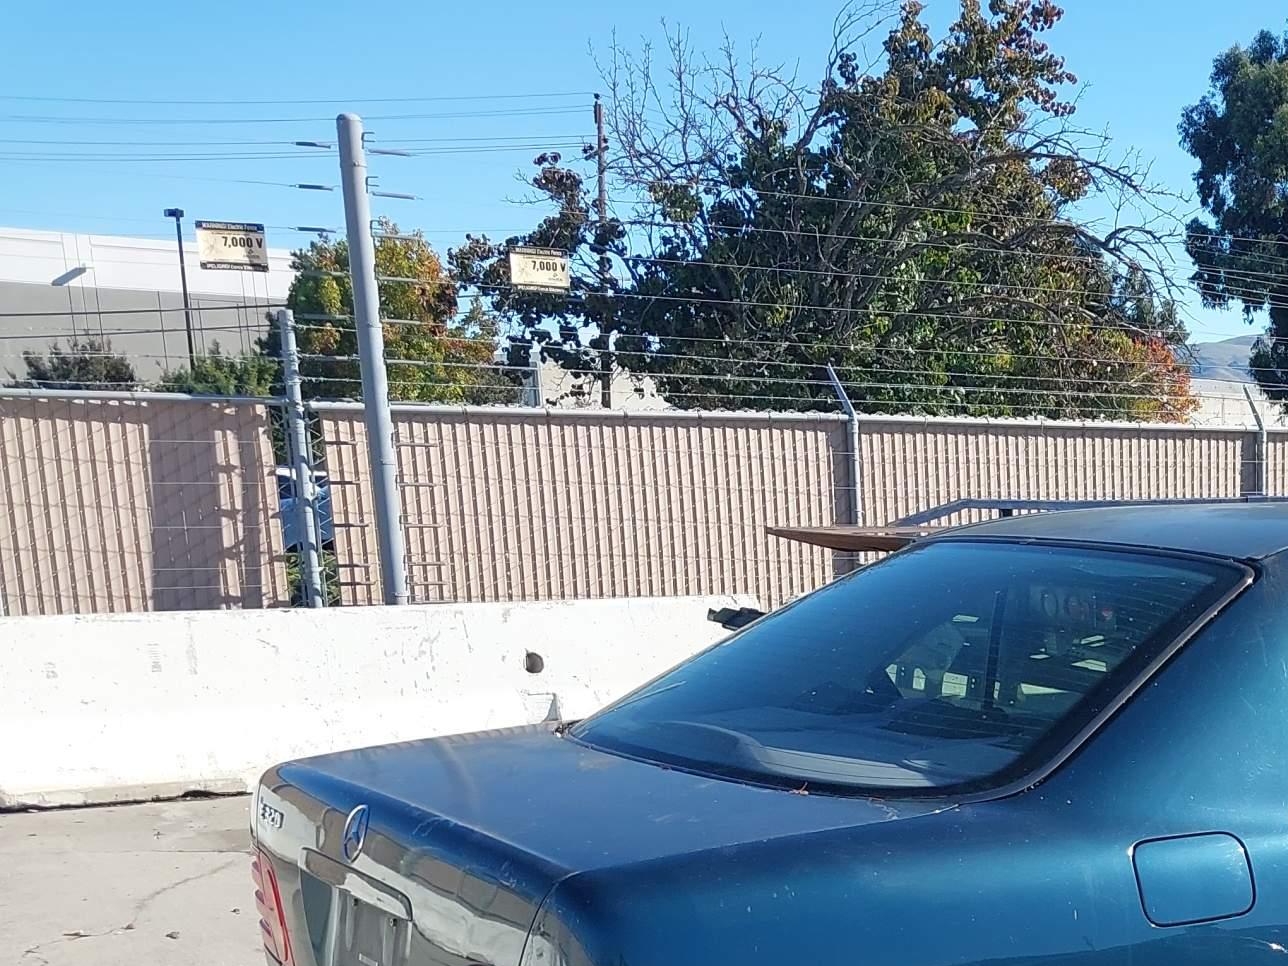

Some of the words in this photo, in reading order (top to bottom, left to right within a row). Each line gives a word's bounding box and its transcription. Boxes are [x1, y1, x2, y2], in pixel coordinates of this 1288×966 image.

[222, 236, 253, 248] 7,000
[255, 237, 263, 249] V
[531, 260, 558, 272] 7,000
[560, 262, 566, 272] V
